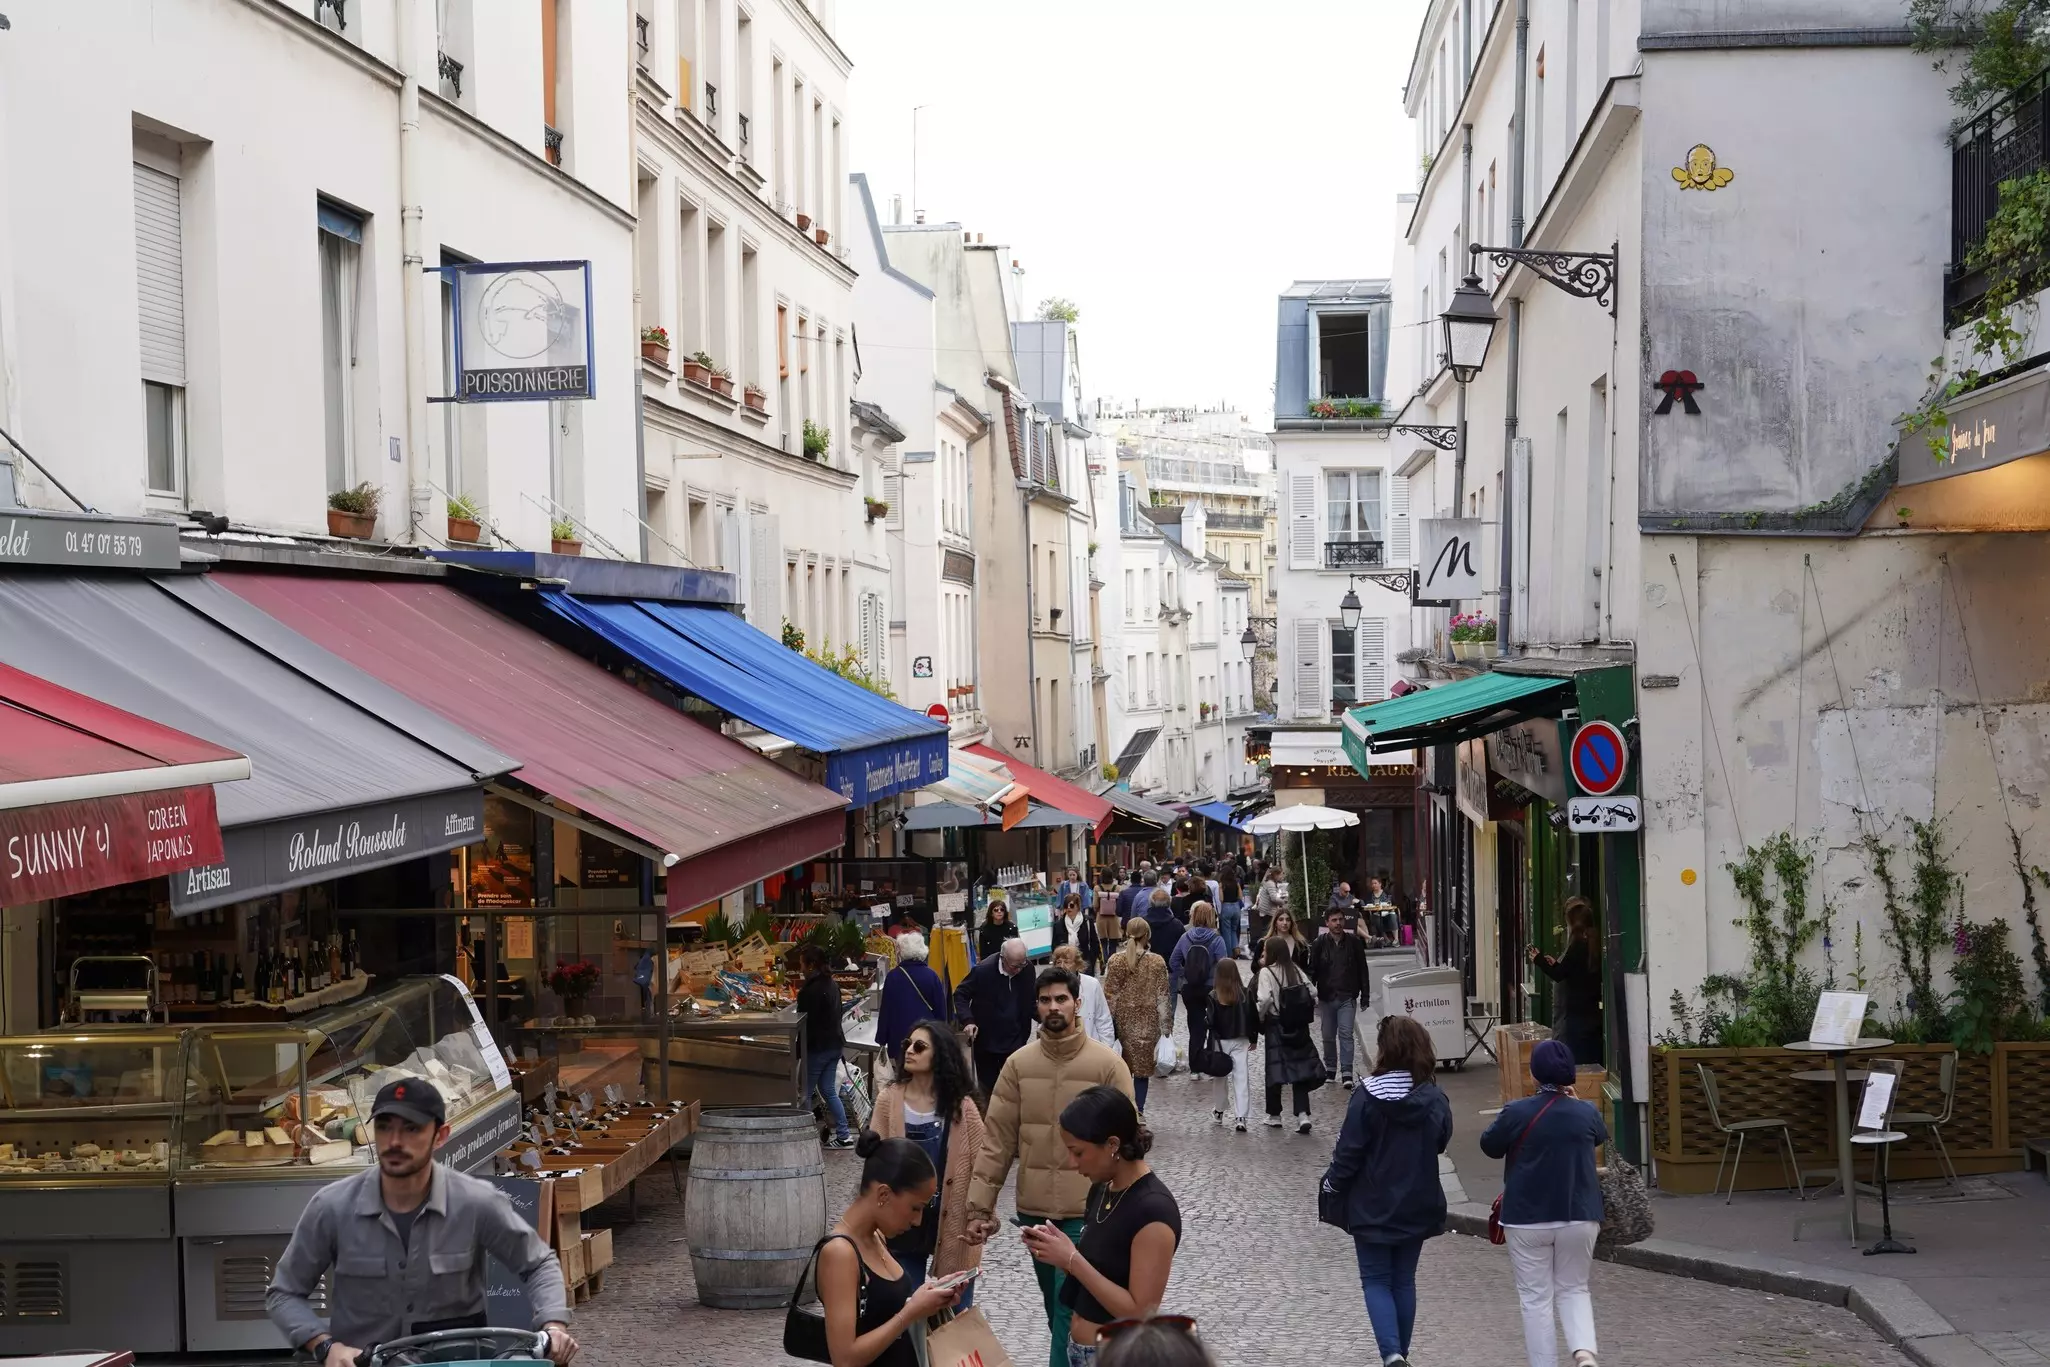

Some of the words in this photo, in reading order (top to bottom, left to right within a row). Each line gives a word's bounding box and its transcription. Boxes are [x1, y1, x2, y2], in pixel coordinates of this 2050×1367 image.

[465, 368, 583, 393] POISSONNERIE
[65, 531, 79, 552] 01
[81, 532, 95, 553] 47
[97, 533, 111, 554] 07
[113, 535, 127, 555] 55
[128, 536, 142, 556] 79
[148, 804, 188, 831] COREEN
[445, 813, 475, 836] Affineur
[9, 826, 86, 878] SUNNY
[289, 824, 343, 872] Roland
[346, 814, 407, 860] Rousselet
[187, 867, 231, 895] Artisan
[1405, 997, 1450, 1009] Berthillon
[467, 1133, 497, 1159] producteurs
[497, 1113, 518, 1139] fermiers
